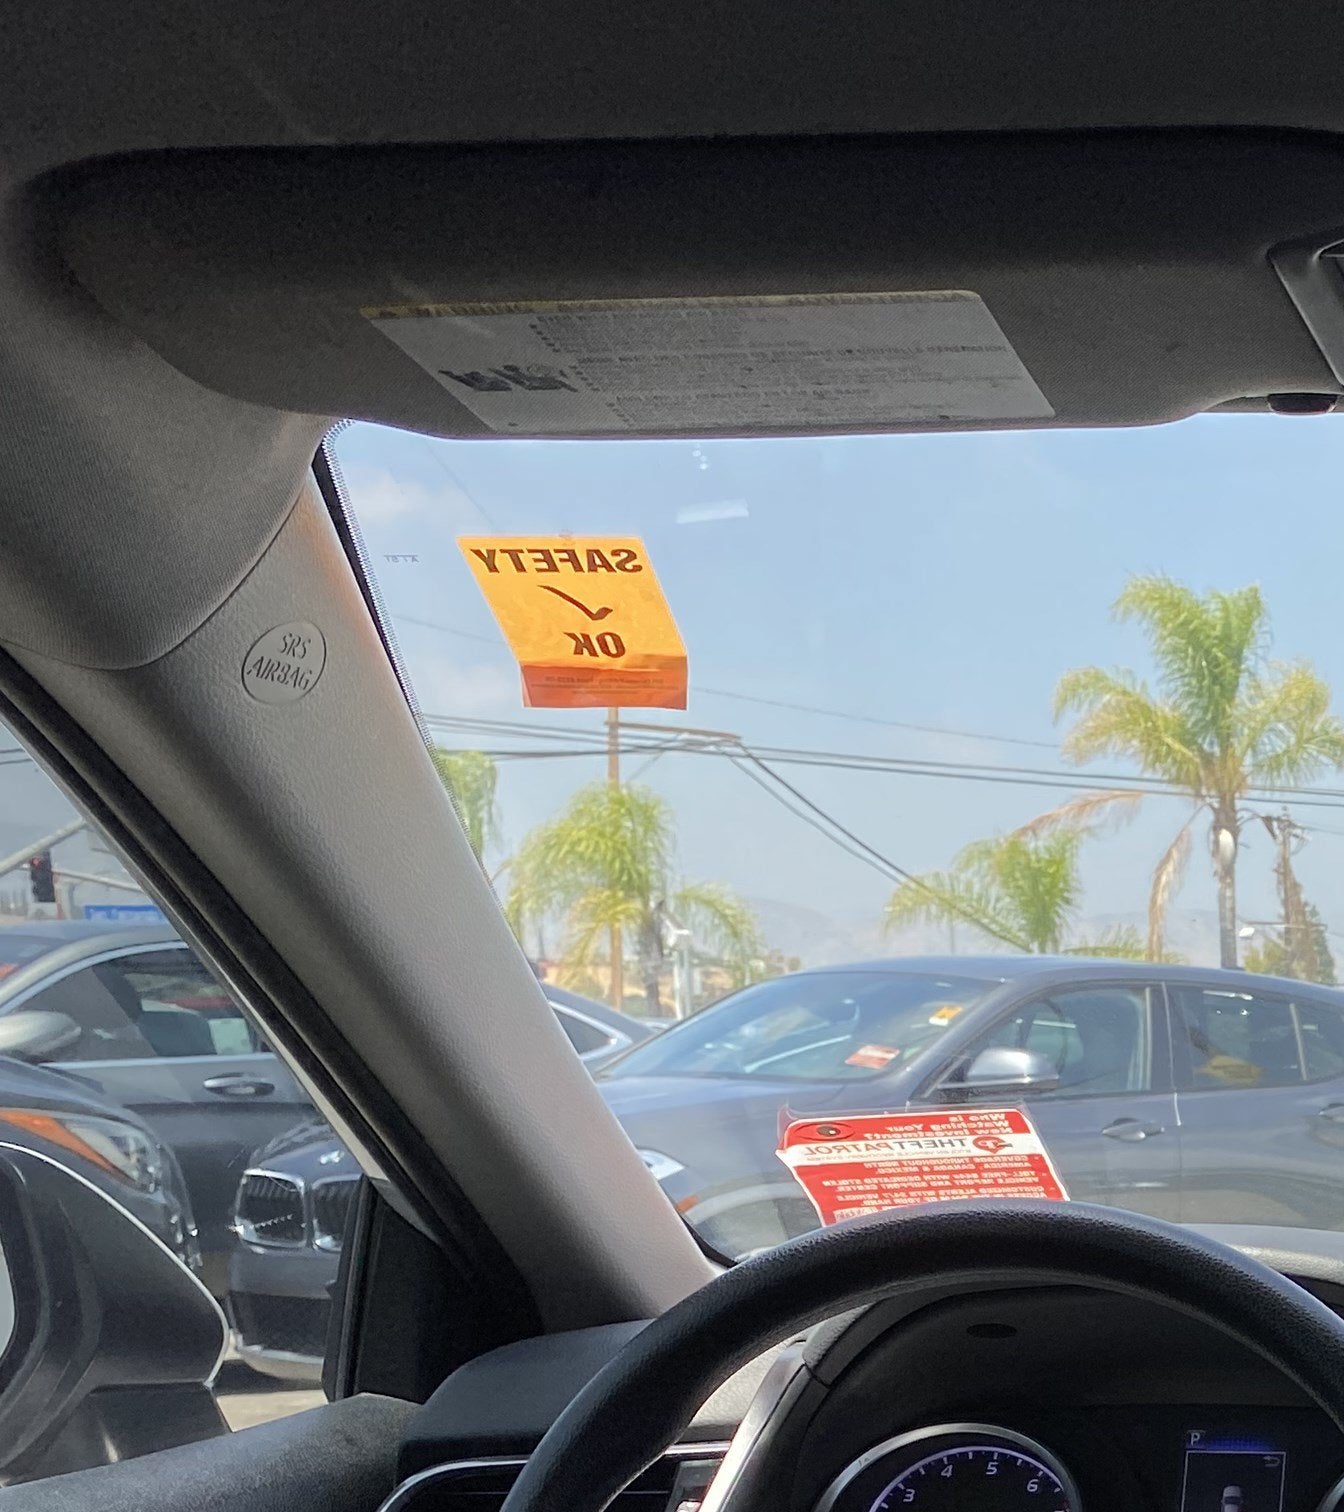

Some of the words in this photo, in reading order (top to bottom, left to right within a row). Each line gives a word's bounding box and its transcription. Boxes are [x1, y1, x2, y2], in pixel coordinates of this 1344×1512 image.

[280, 633, 311, 659] SRS
[246, 656, 312, 690] AIRBAG
[1190, 1432, 1201, 1446] P
[941, 1465, 953, 1478] 4
[986, 1462, 999, 1475] 5
[1026, 1479, 1039, 1492] 6
[903, 1488, 915, 1502] 3
